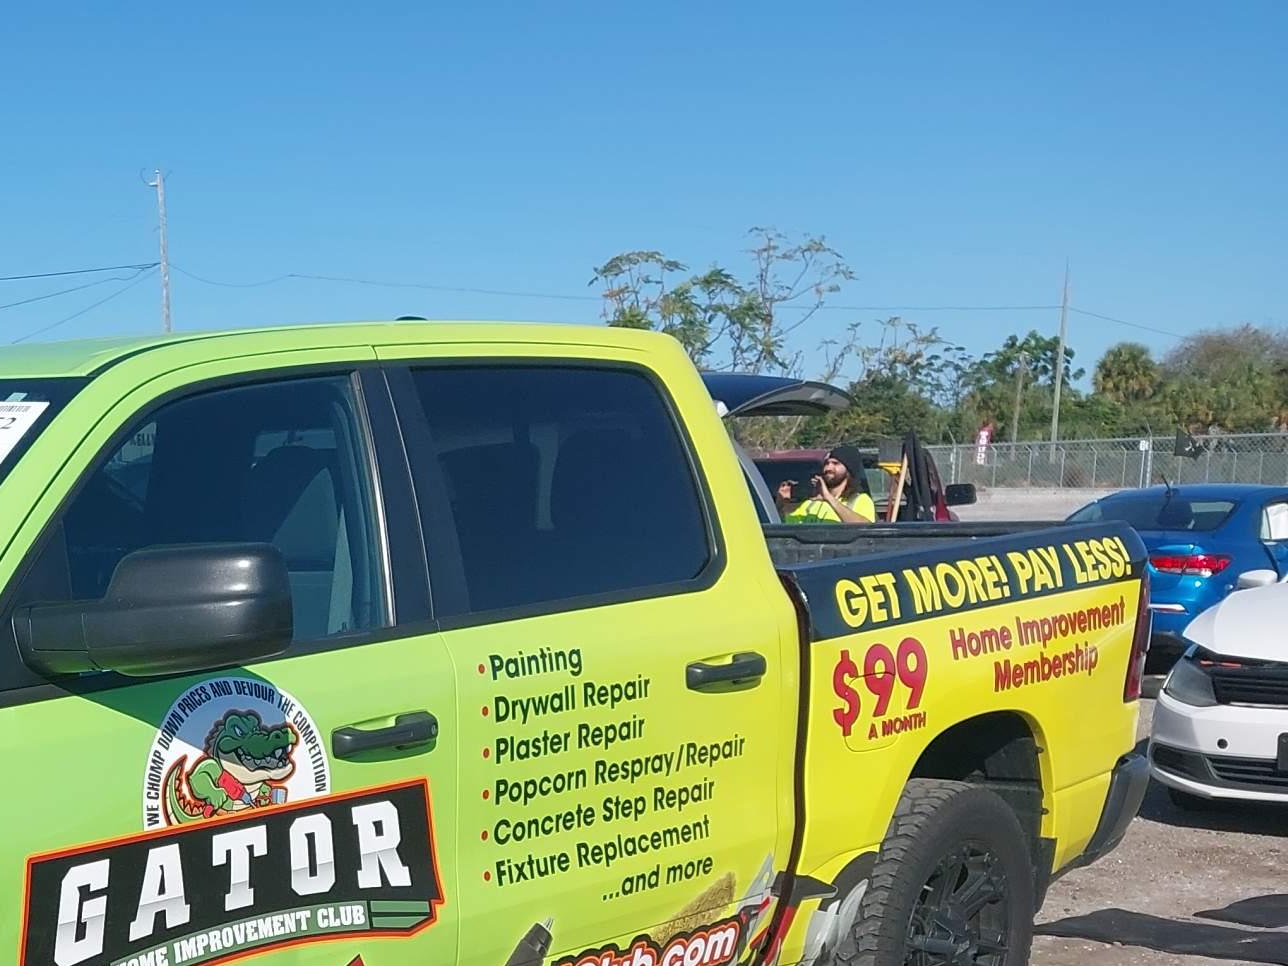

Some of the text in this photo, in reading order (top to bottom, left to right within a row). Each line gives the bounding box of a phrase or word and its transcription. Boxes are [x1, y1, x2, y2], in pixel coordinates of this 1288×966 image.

[834, 536, 1133, 629] GET MORE! PAY LESS!
[949, 595, 1126, 661] Home Improvement
[489, 647, 583, 681] Painting
[833, 636, 928, 736] $99
[993, 642, 1099, 692] Membership
[494, 674, 651, 725] Drywall Repair
[868, 711, 927, 740] A MONTH
[147, 680, 327, 827] WE CHOMP DOWN PRICES AND DEVOUR THE COMPETITION
[495, 715, 646, 764] Plaster Repair
[495, 734, 746, 806] Popcorn Respray/Repair
[493, 777, 716, 845] Concrete Step Repair
[495, 815, 711, 887] Fixture Replacement
[602, 855, 713, 901] ...and more
[173, 909, 312, 964] IMPROVEMENT
[316, 904, 366, 929] CLUB
